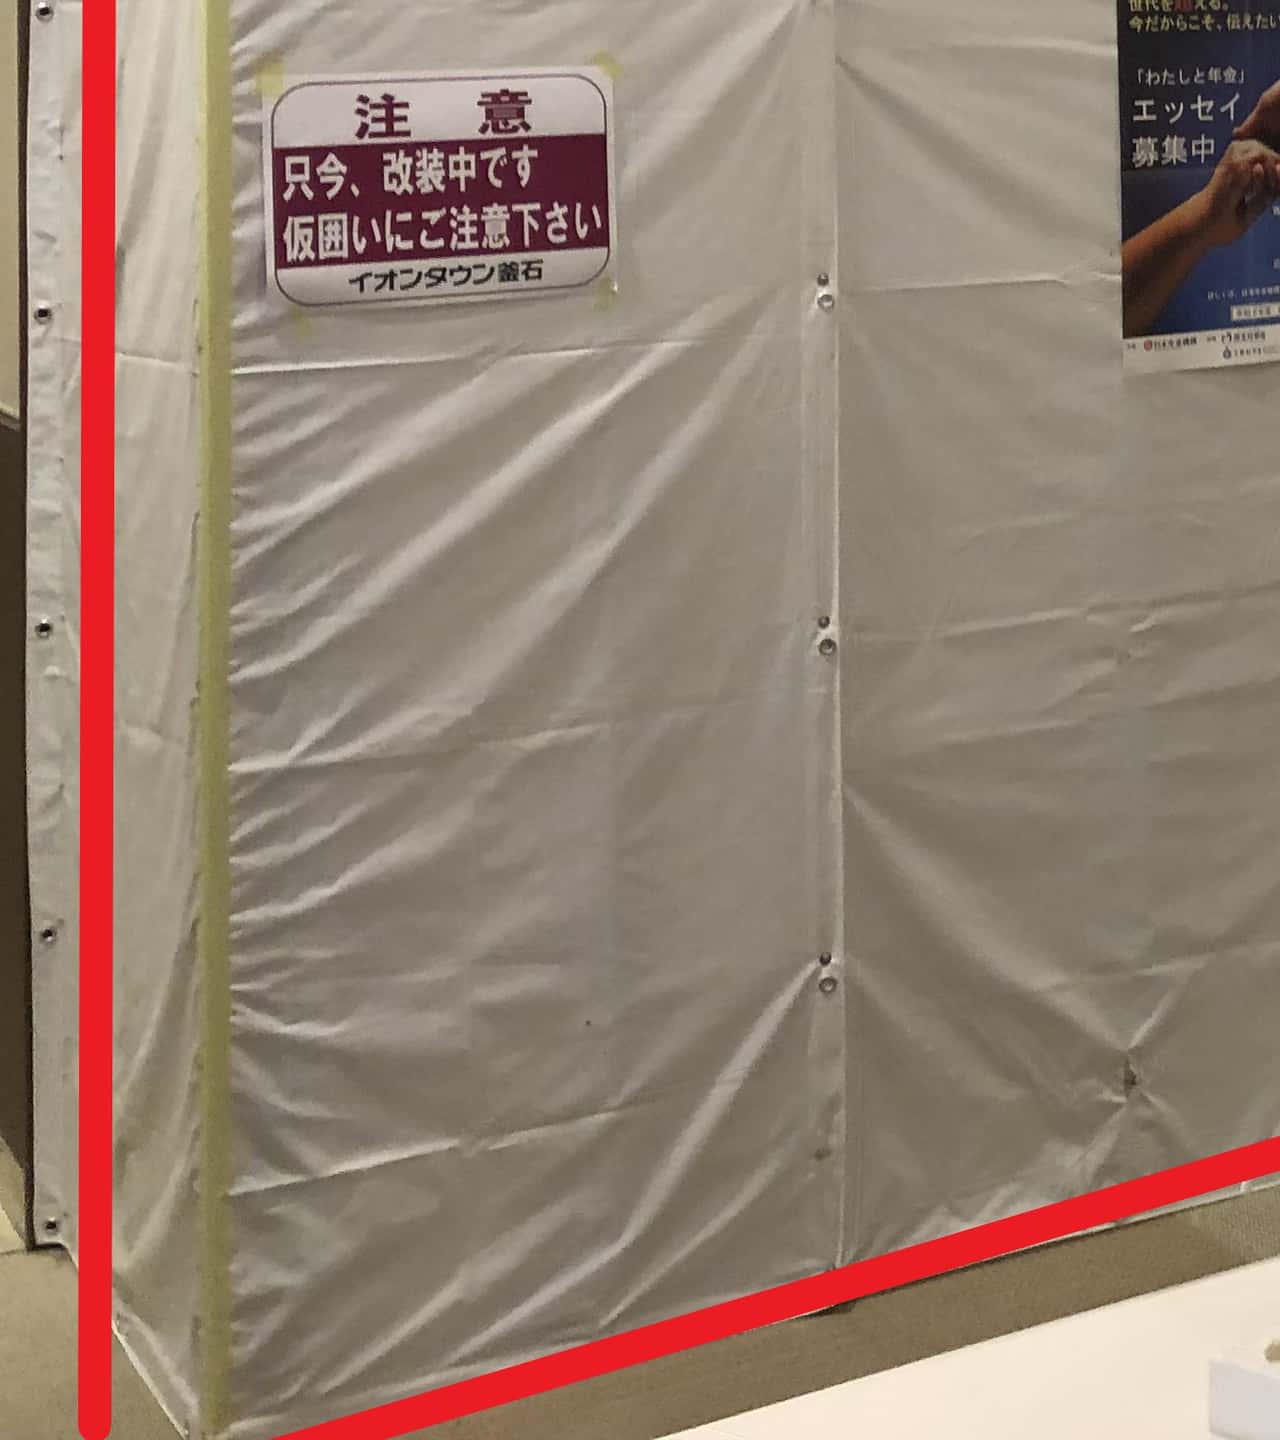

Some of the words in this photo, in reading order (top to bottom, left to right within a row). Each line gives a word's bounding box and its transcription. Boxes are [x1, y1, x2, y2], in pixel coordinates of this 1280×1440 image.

[1133, 93, 1241, 123] エッセイ
[1132, 134, 1215, 168] 募集中
[283, 201, 602, 263] 仮囲いにご注意下さい
[348, 259, 544, 293] イオンタウン釜石
